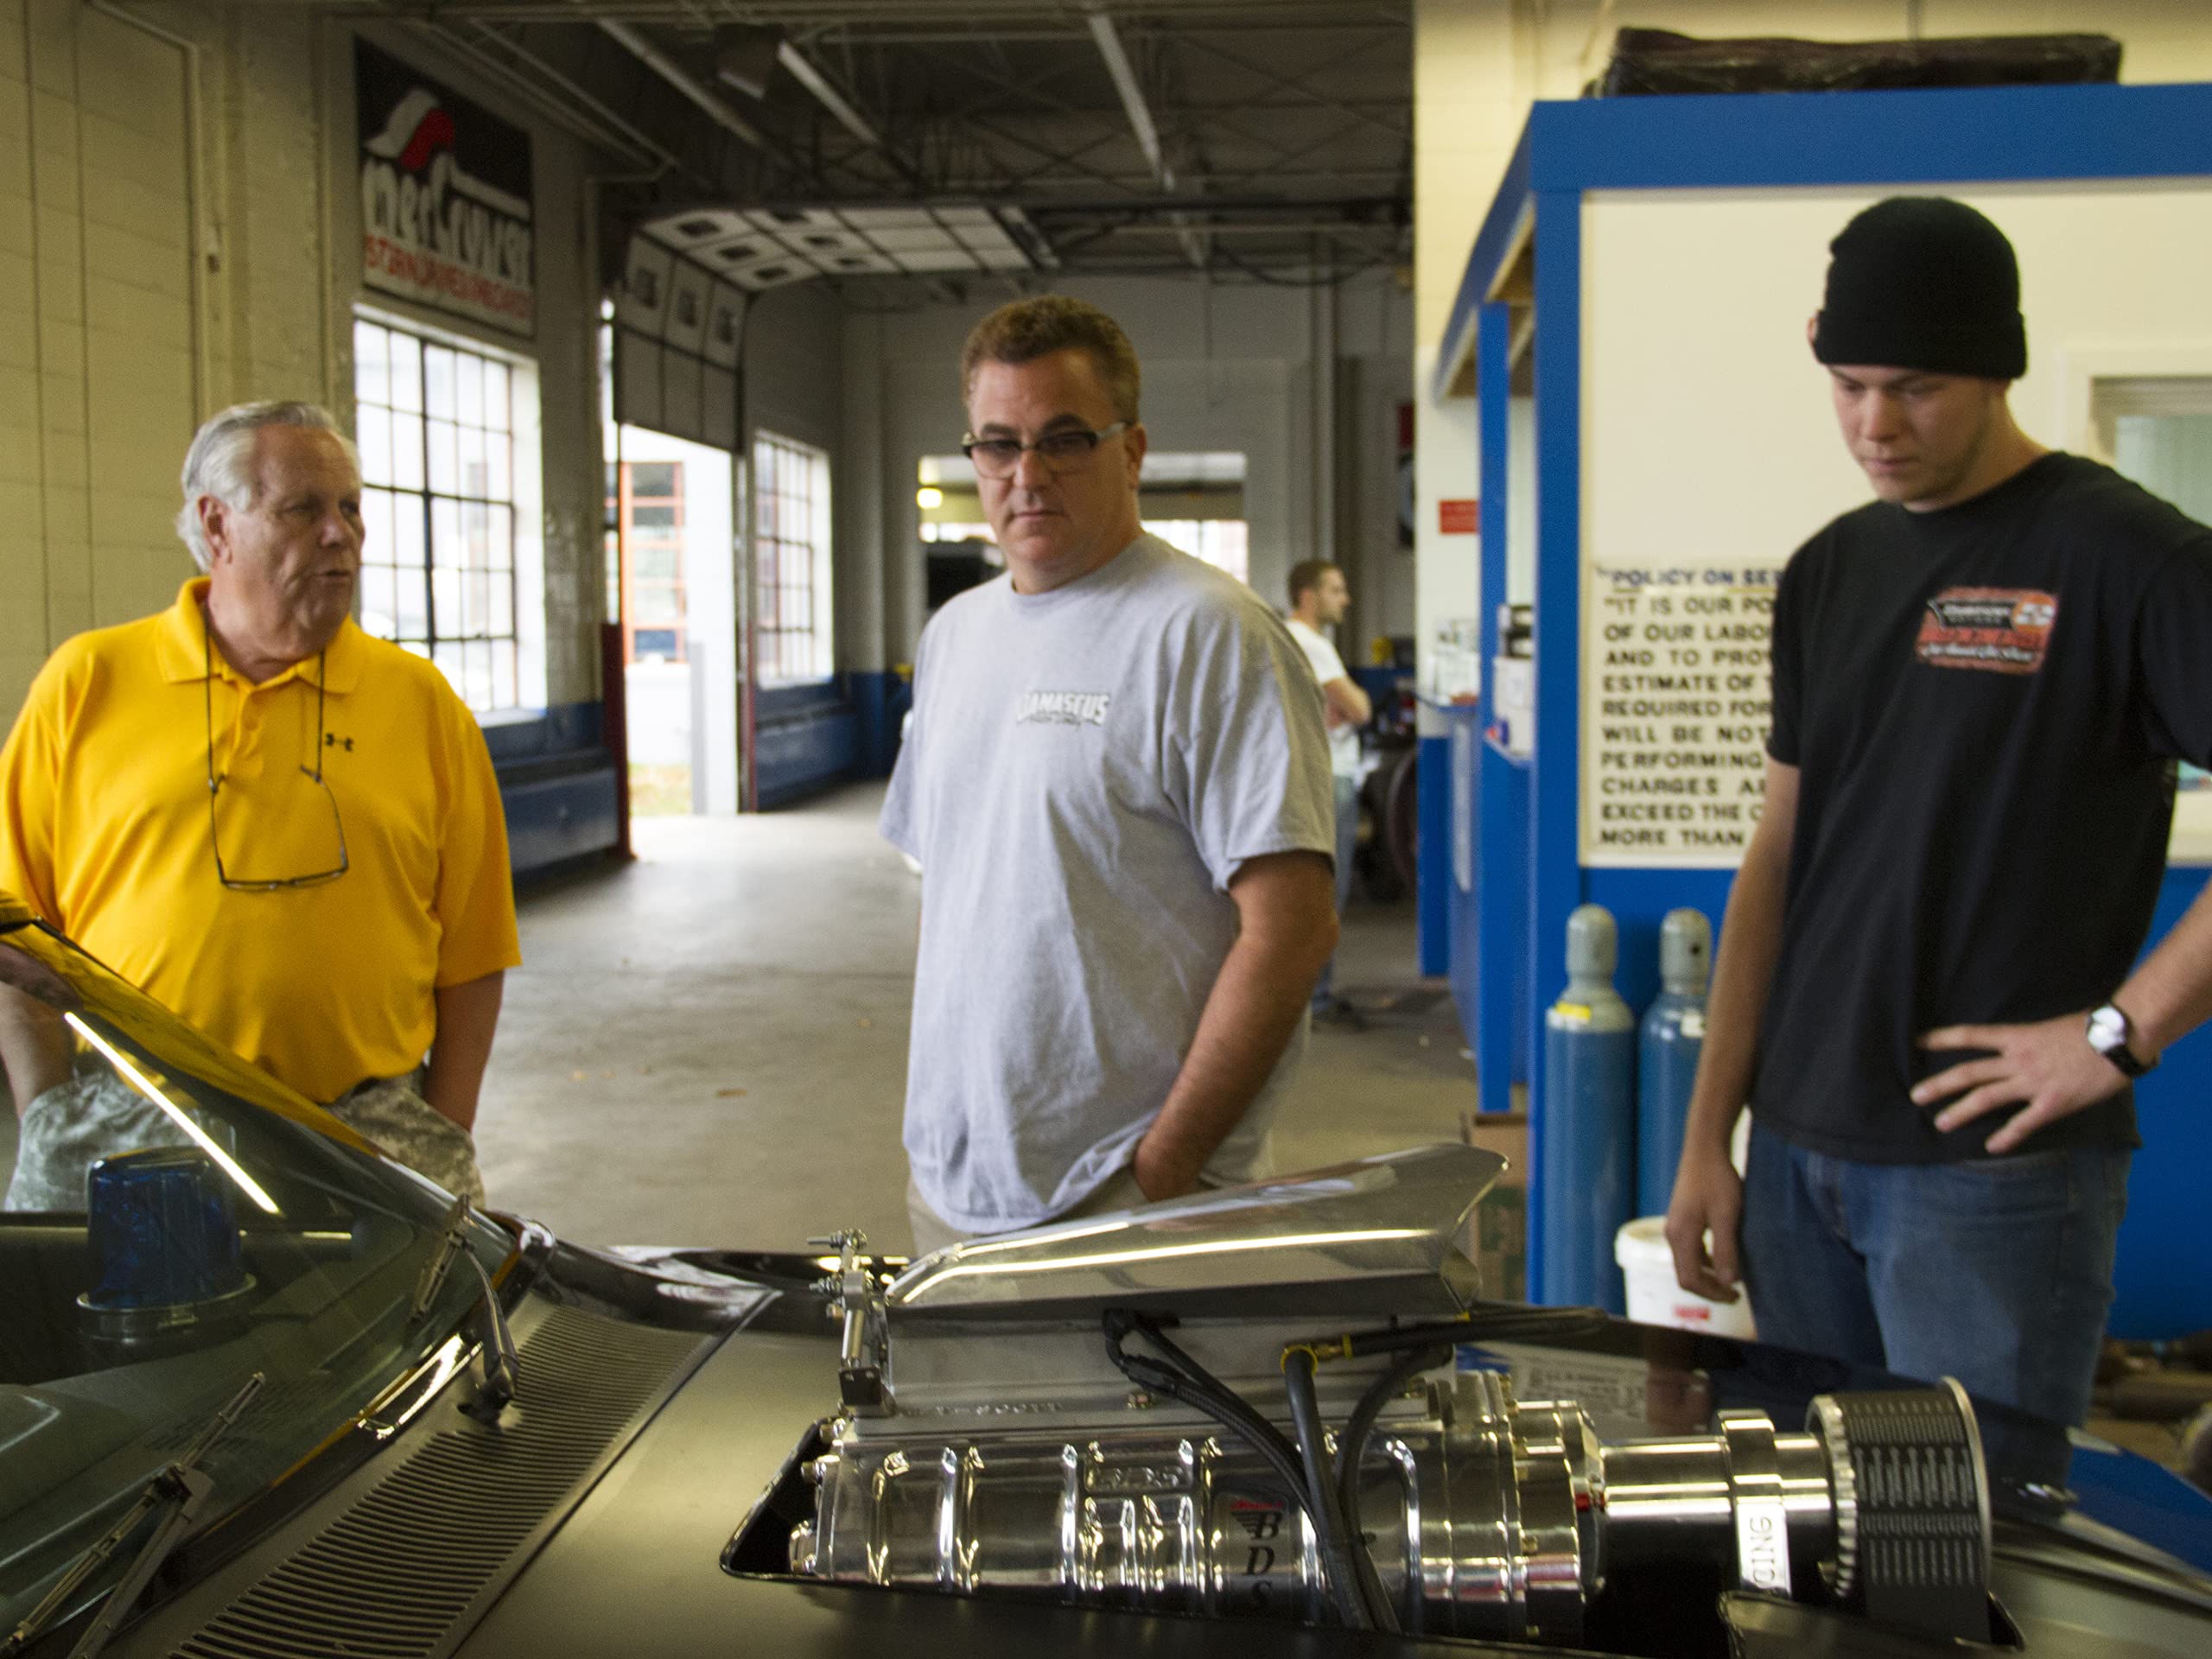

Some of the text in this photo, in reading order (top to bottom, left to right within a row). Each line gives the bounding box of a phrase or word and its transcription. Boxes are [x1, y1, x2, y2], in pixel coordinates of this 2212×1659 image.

[1704, 569, 1733, 585] ON
[1650, 597, 1672, 613] IS
[1684, 597, 1731, 613] OUR
[1604, 623, 1632, 641] OF
[1644, 623, 1693, 641] OUR
[1606, 649, 1654, 666] AND
[1669, 649, 1700, 666] TO
[1604, 674, 1717, 692] ESTIMATE
[1726, 674, 1754, 692] OF
[1603, 700, 1721, 717] REQUIRED
[1603, 726, 1656, 743] WILL
[1672, 726, 1701, 743] BE
[1601, 752, 1763, 769] PERFORMING
[1601, 778, 1718, 795] CHARGES
[1602, 804, 1694, 821] EXCEED
[1701, 804, 1739, 821] THE
[1600, 828, 1745, 846] MORE THAN
